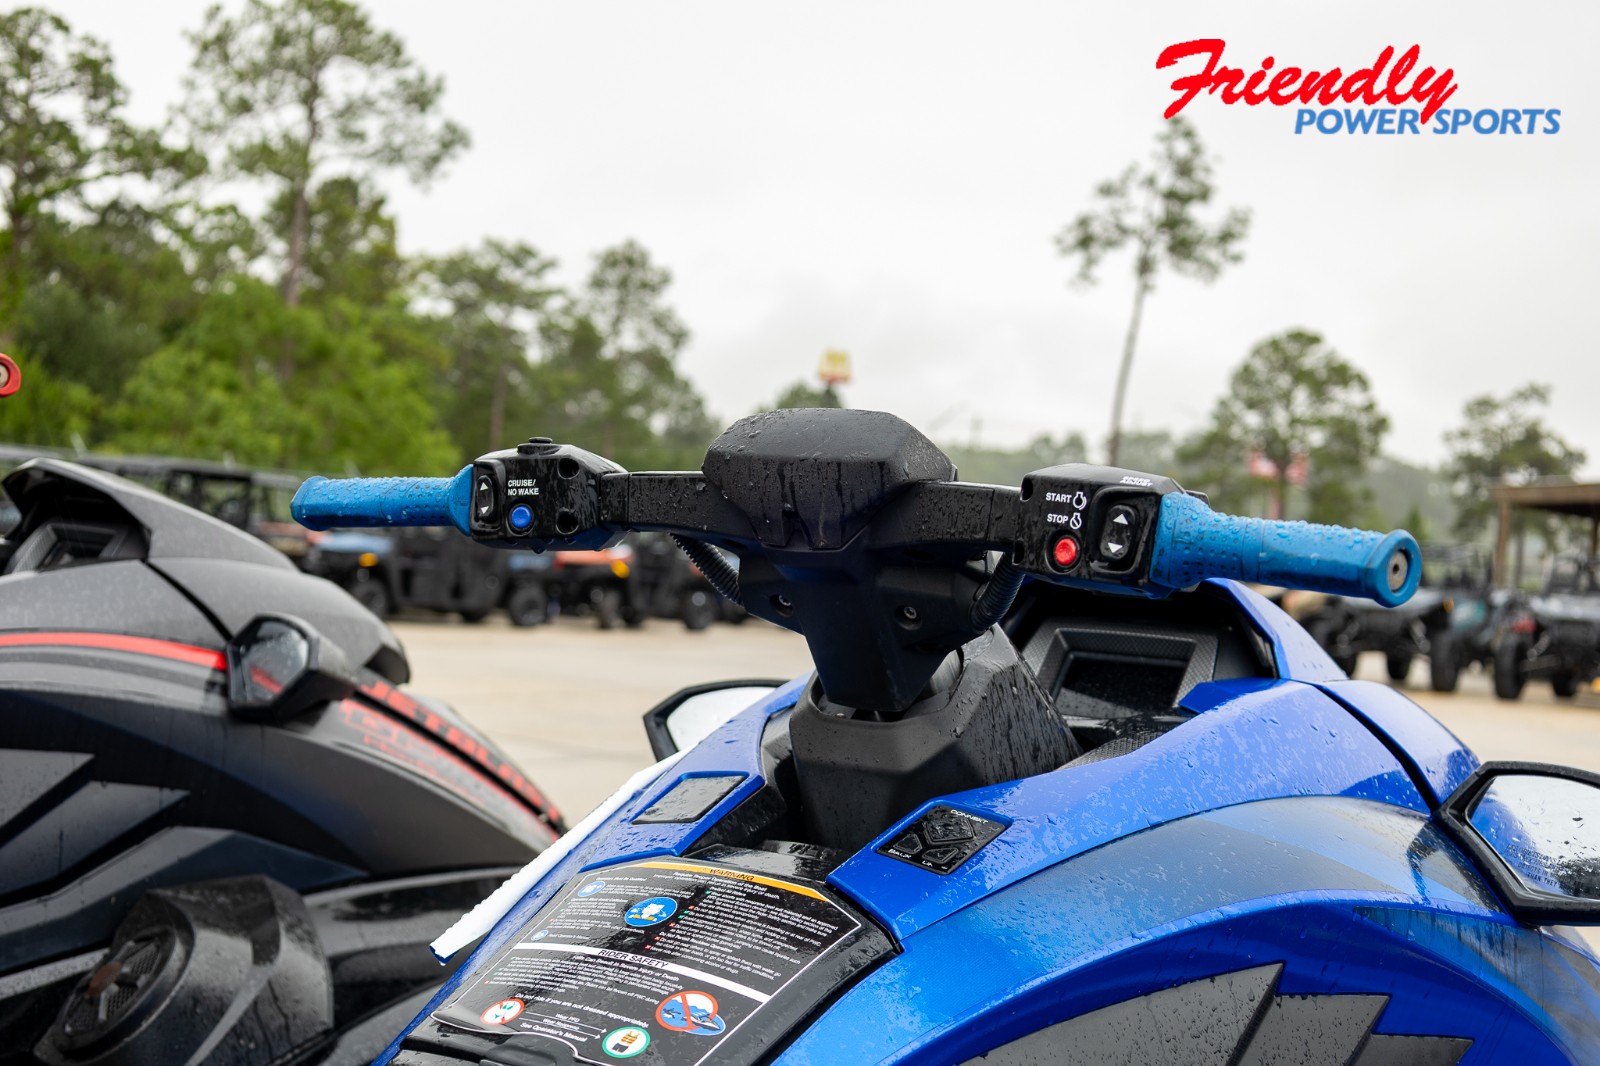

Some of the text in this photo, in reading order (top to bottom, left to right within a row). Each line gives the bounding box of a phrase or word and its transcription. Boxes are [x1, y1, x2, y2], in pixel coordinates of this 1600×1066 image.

[508, 479, 536, 487] CRUISE/
[508, 488, 539, 496] NO WAKE
[1046, 492, 1072, 503] START
[1047, 514, 1068, 524] STOP
[709, 868, 754, 881] WARNING
[1544, 878, 1558, 887] THEY
[598, 950, 669, 968] RIDER SAFETY
[583, 1005, 608, 1016] dressed
[608, 1012, 649, 1028] appropriately.
[533, 1024, 563, 1036] Operator's
[563, 1031, 588, 1042] Manual
